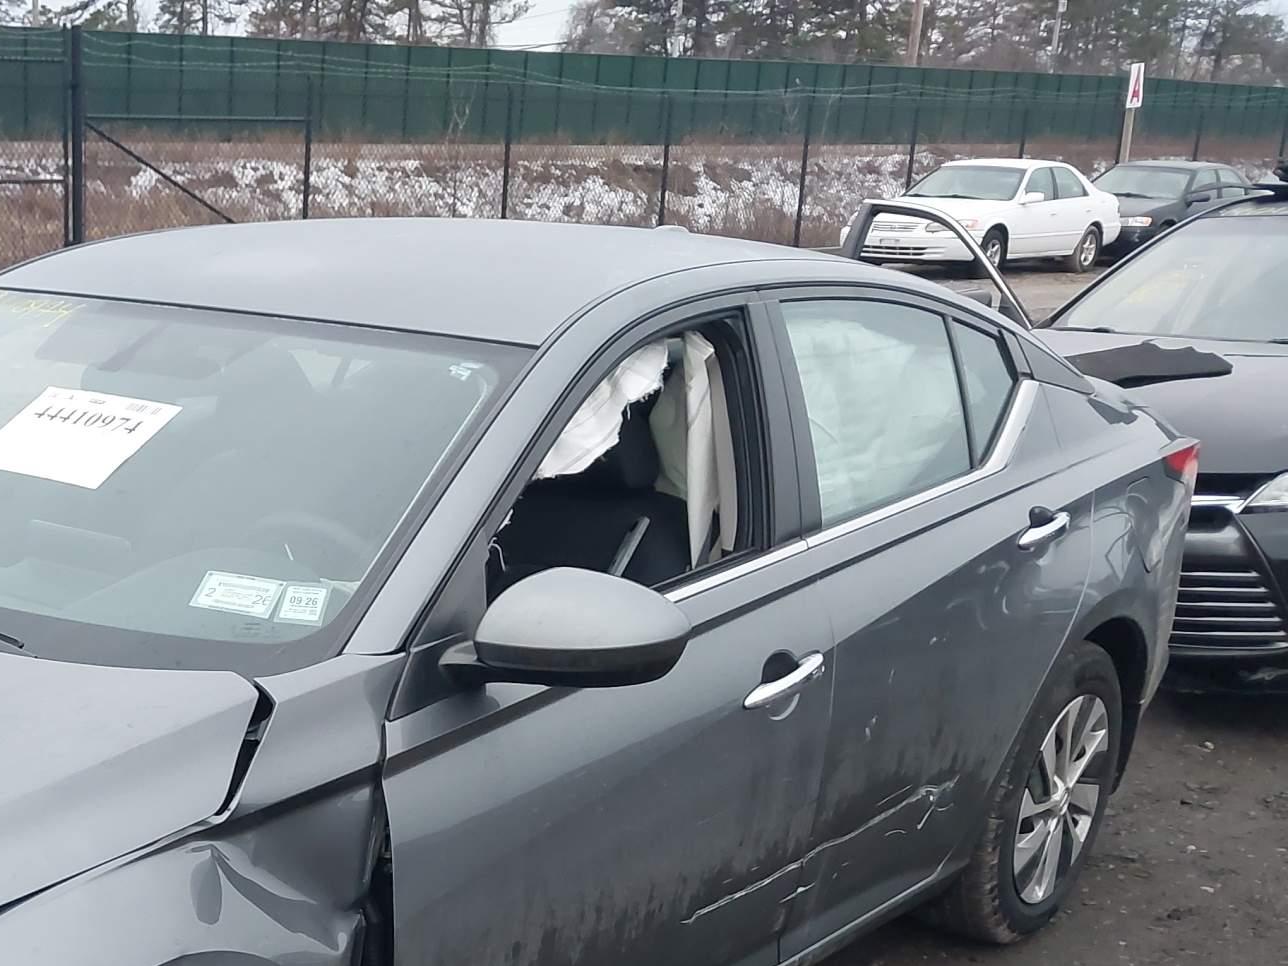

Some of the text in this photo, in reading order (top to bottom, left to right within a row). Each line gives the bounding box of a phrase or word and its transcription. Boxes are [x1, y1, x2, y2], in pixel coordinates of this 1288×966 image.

[1130, 64, 1141, 104] A
[33, 405, 144, 434] 44410974
[289, 595, 318, 607] 09 26
